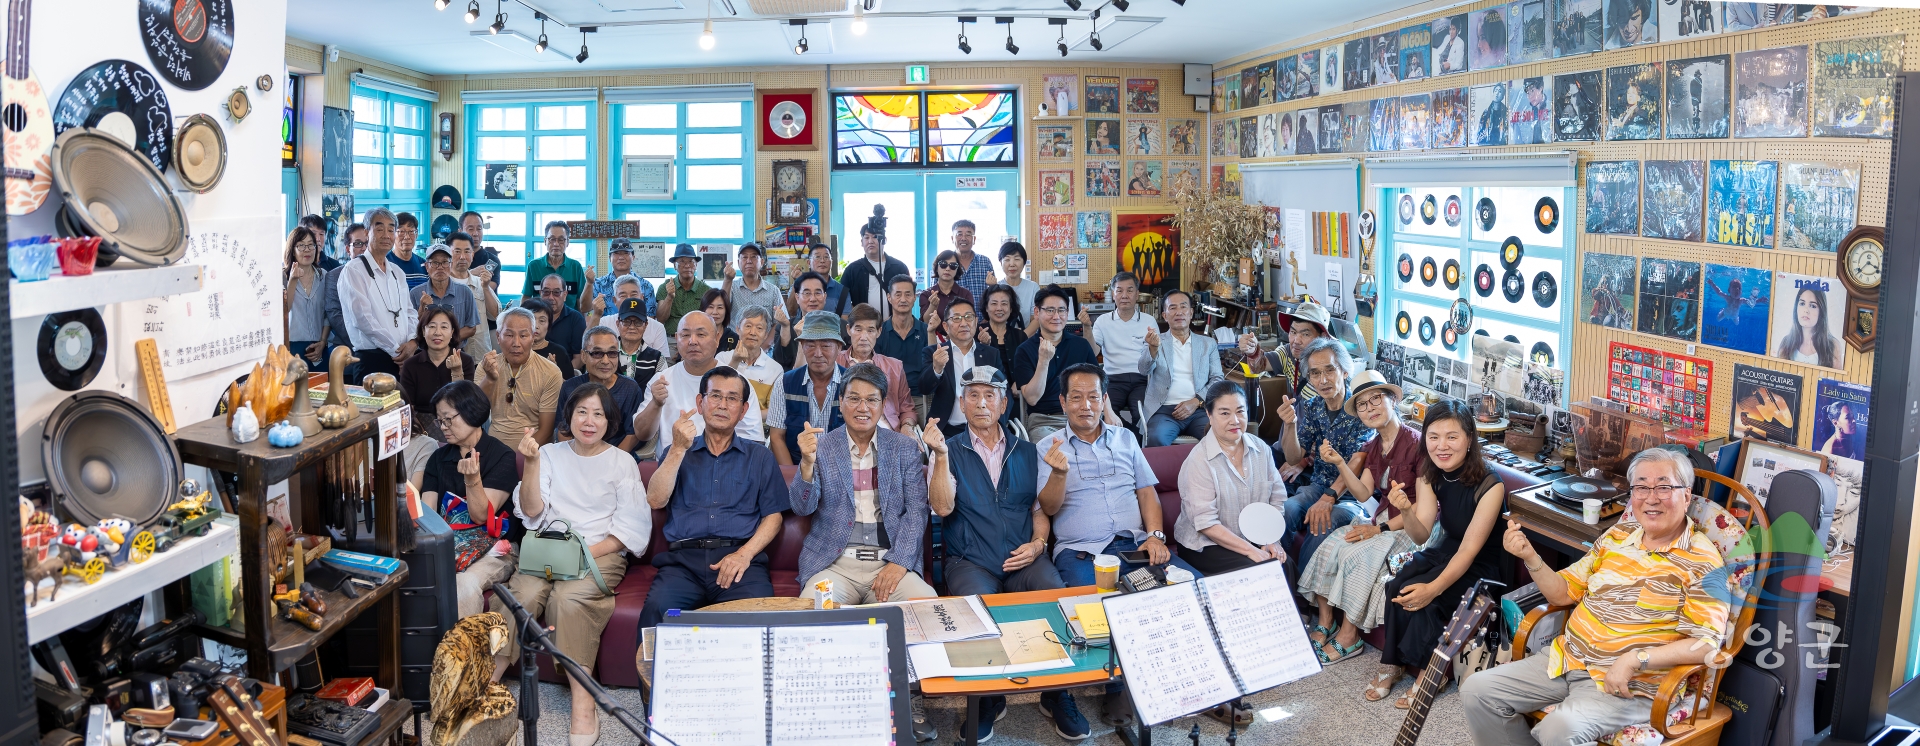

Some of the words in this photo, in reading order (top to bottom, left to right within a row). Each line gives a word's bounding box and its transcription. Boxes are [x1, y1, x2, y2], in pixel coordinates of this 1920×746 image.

[1409, 30, 1431, 48] GOLD
[1794, 278, 1829, 292] nada
[1741, 369, 1770, 382] ACOUSTIC
[1769, 375, 1794, 386] GUITARS
[1823, 386, 1840, 398] Lady
[1841, 389, 1848, 398] in
[1848, 391, 1867, 403] Satin
